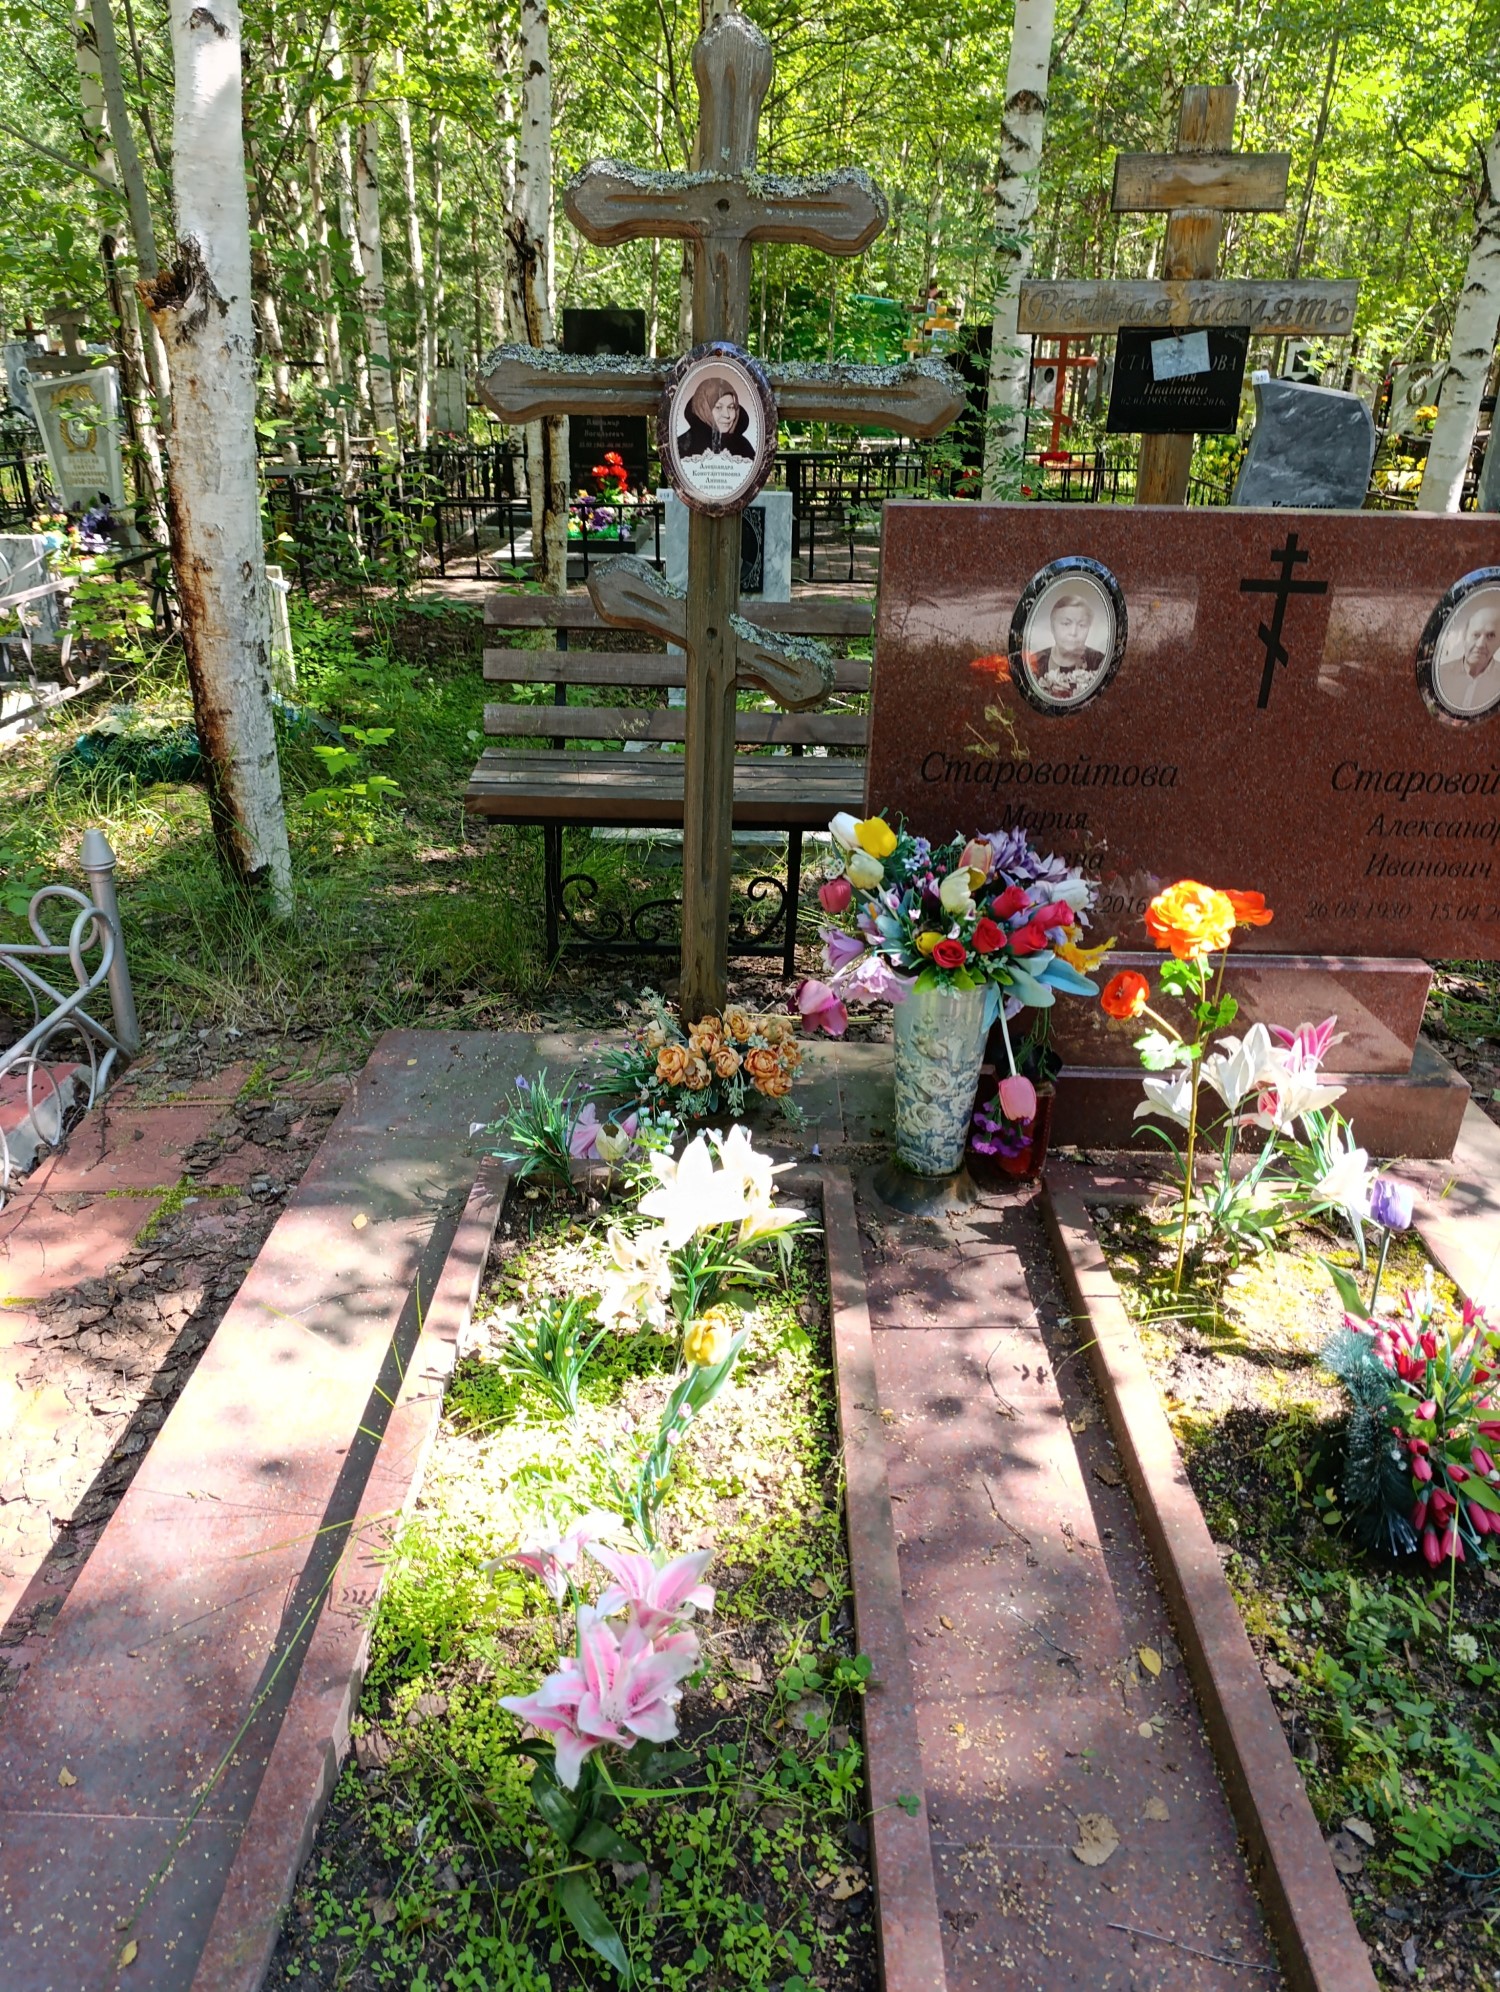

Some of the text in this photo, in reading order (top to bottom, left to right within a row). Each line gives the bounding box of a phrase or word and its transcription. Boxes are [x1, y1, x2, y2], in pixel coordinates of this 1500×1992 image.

[1027, 289, 1350, 324] Вечная память
[921, 751, 1179, 792] Старовойтова
[1000, 804, 1089, 832] Мария
[1364, 853, 1492, 879] Иванович
